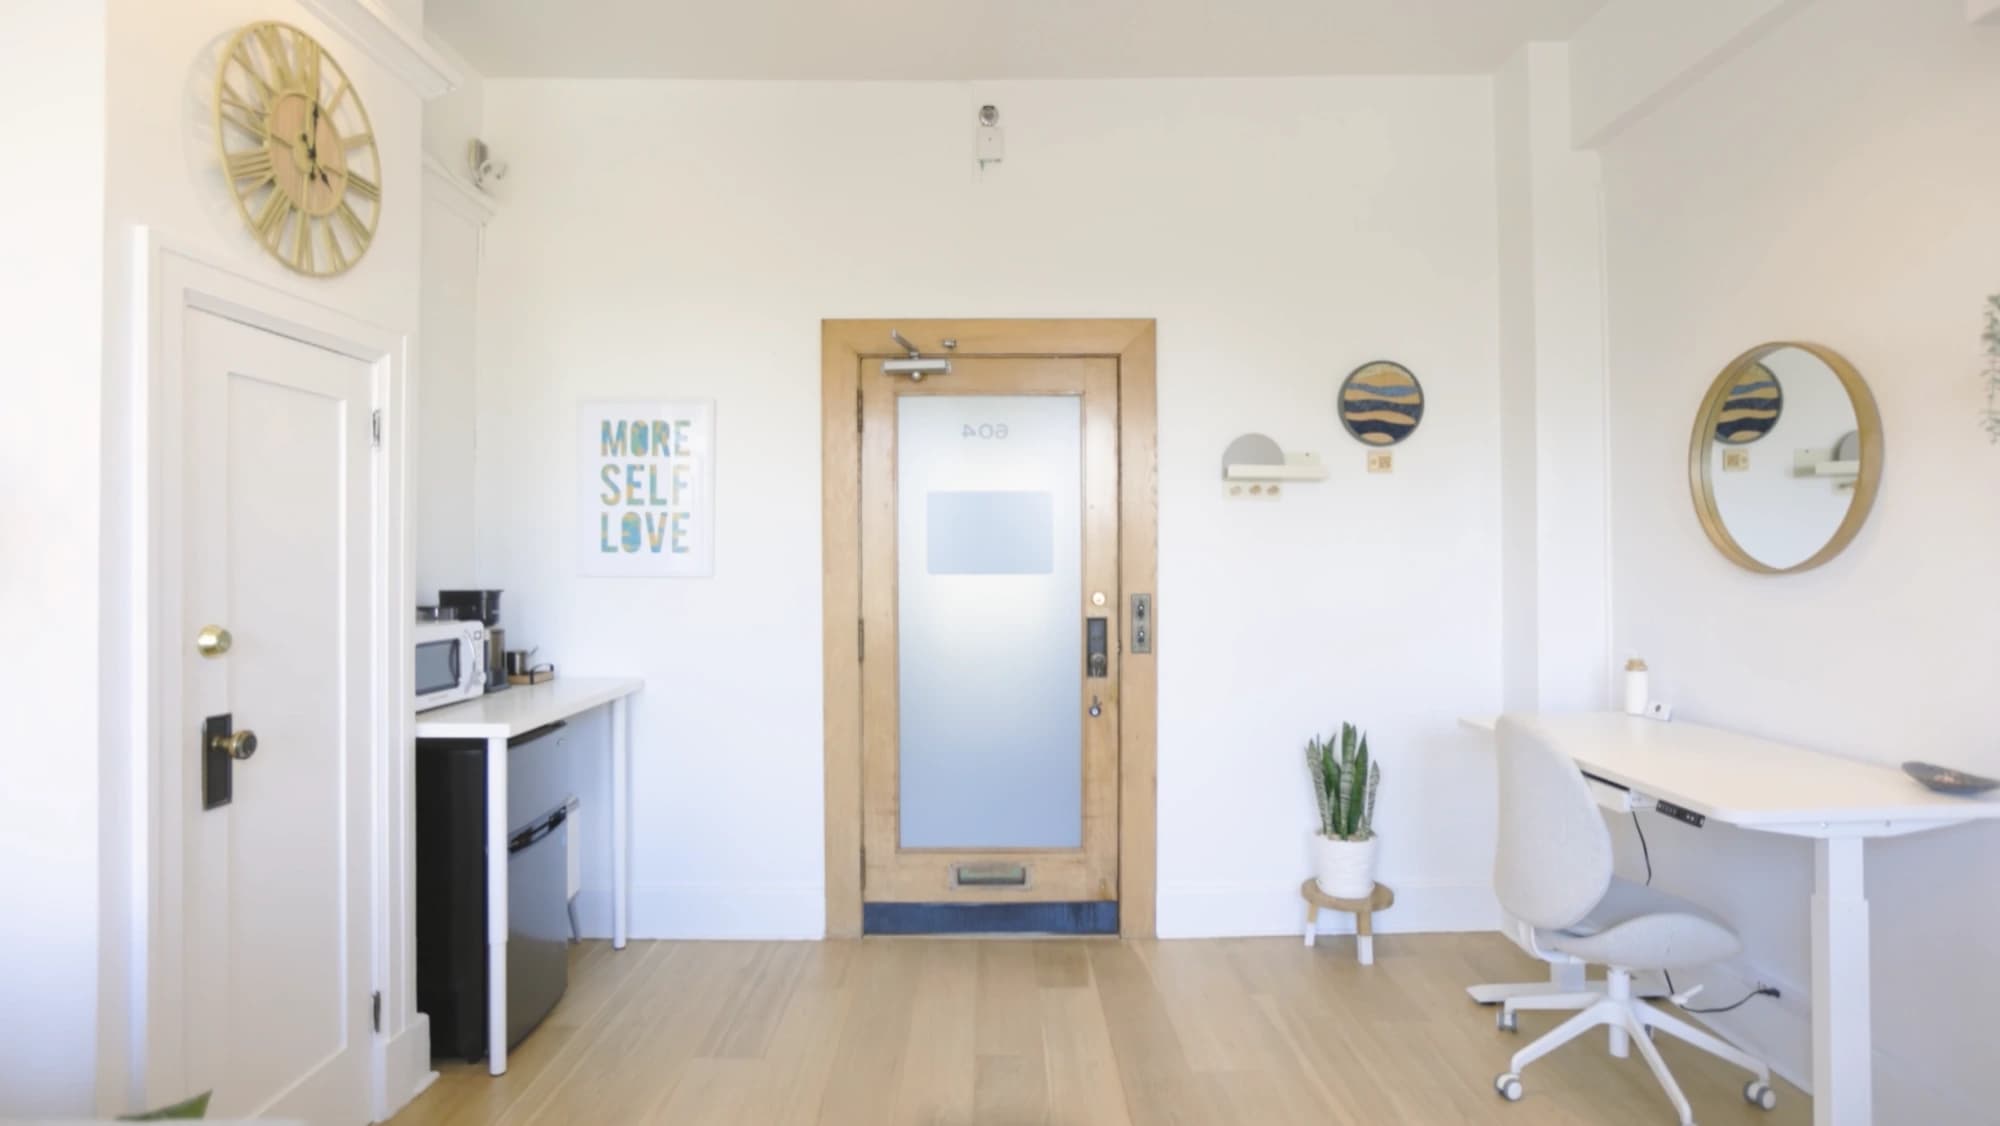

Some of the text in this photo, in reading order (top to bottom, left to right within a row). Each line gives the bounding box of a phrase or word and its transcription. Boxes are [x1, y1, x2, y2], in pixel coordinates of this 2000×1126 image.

[600, 419, 691, 458] MORE
[600, 463, 691, 507] SELF
[600, 511, 691, 554] LOVE
